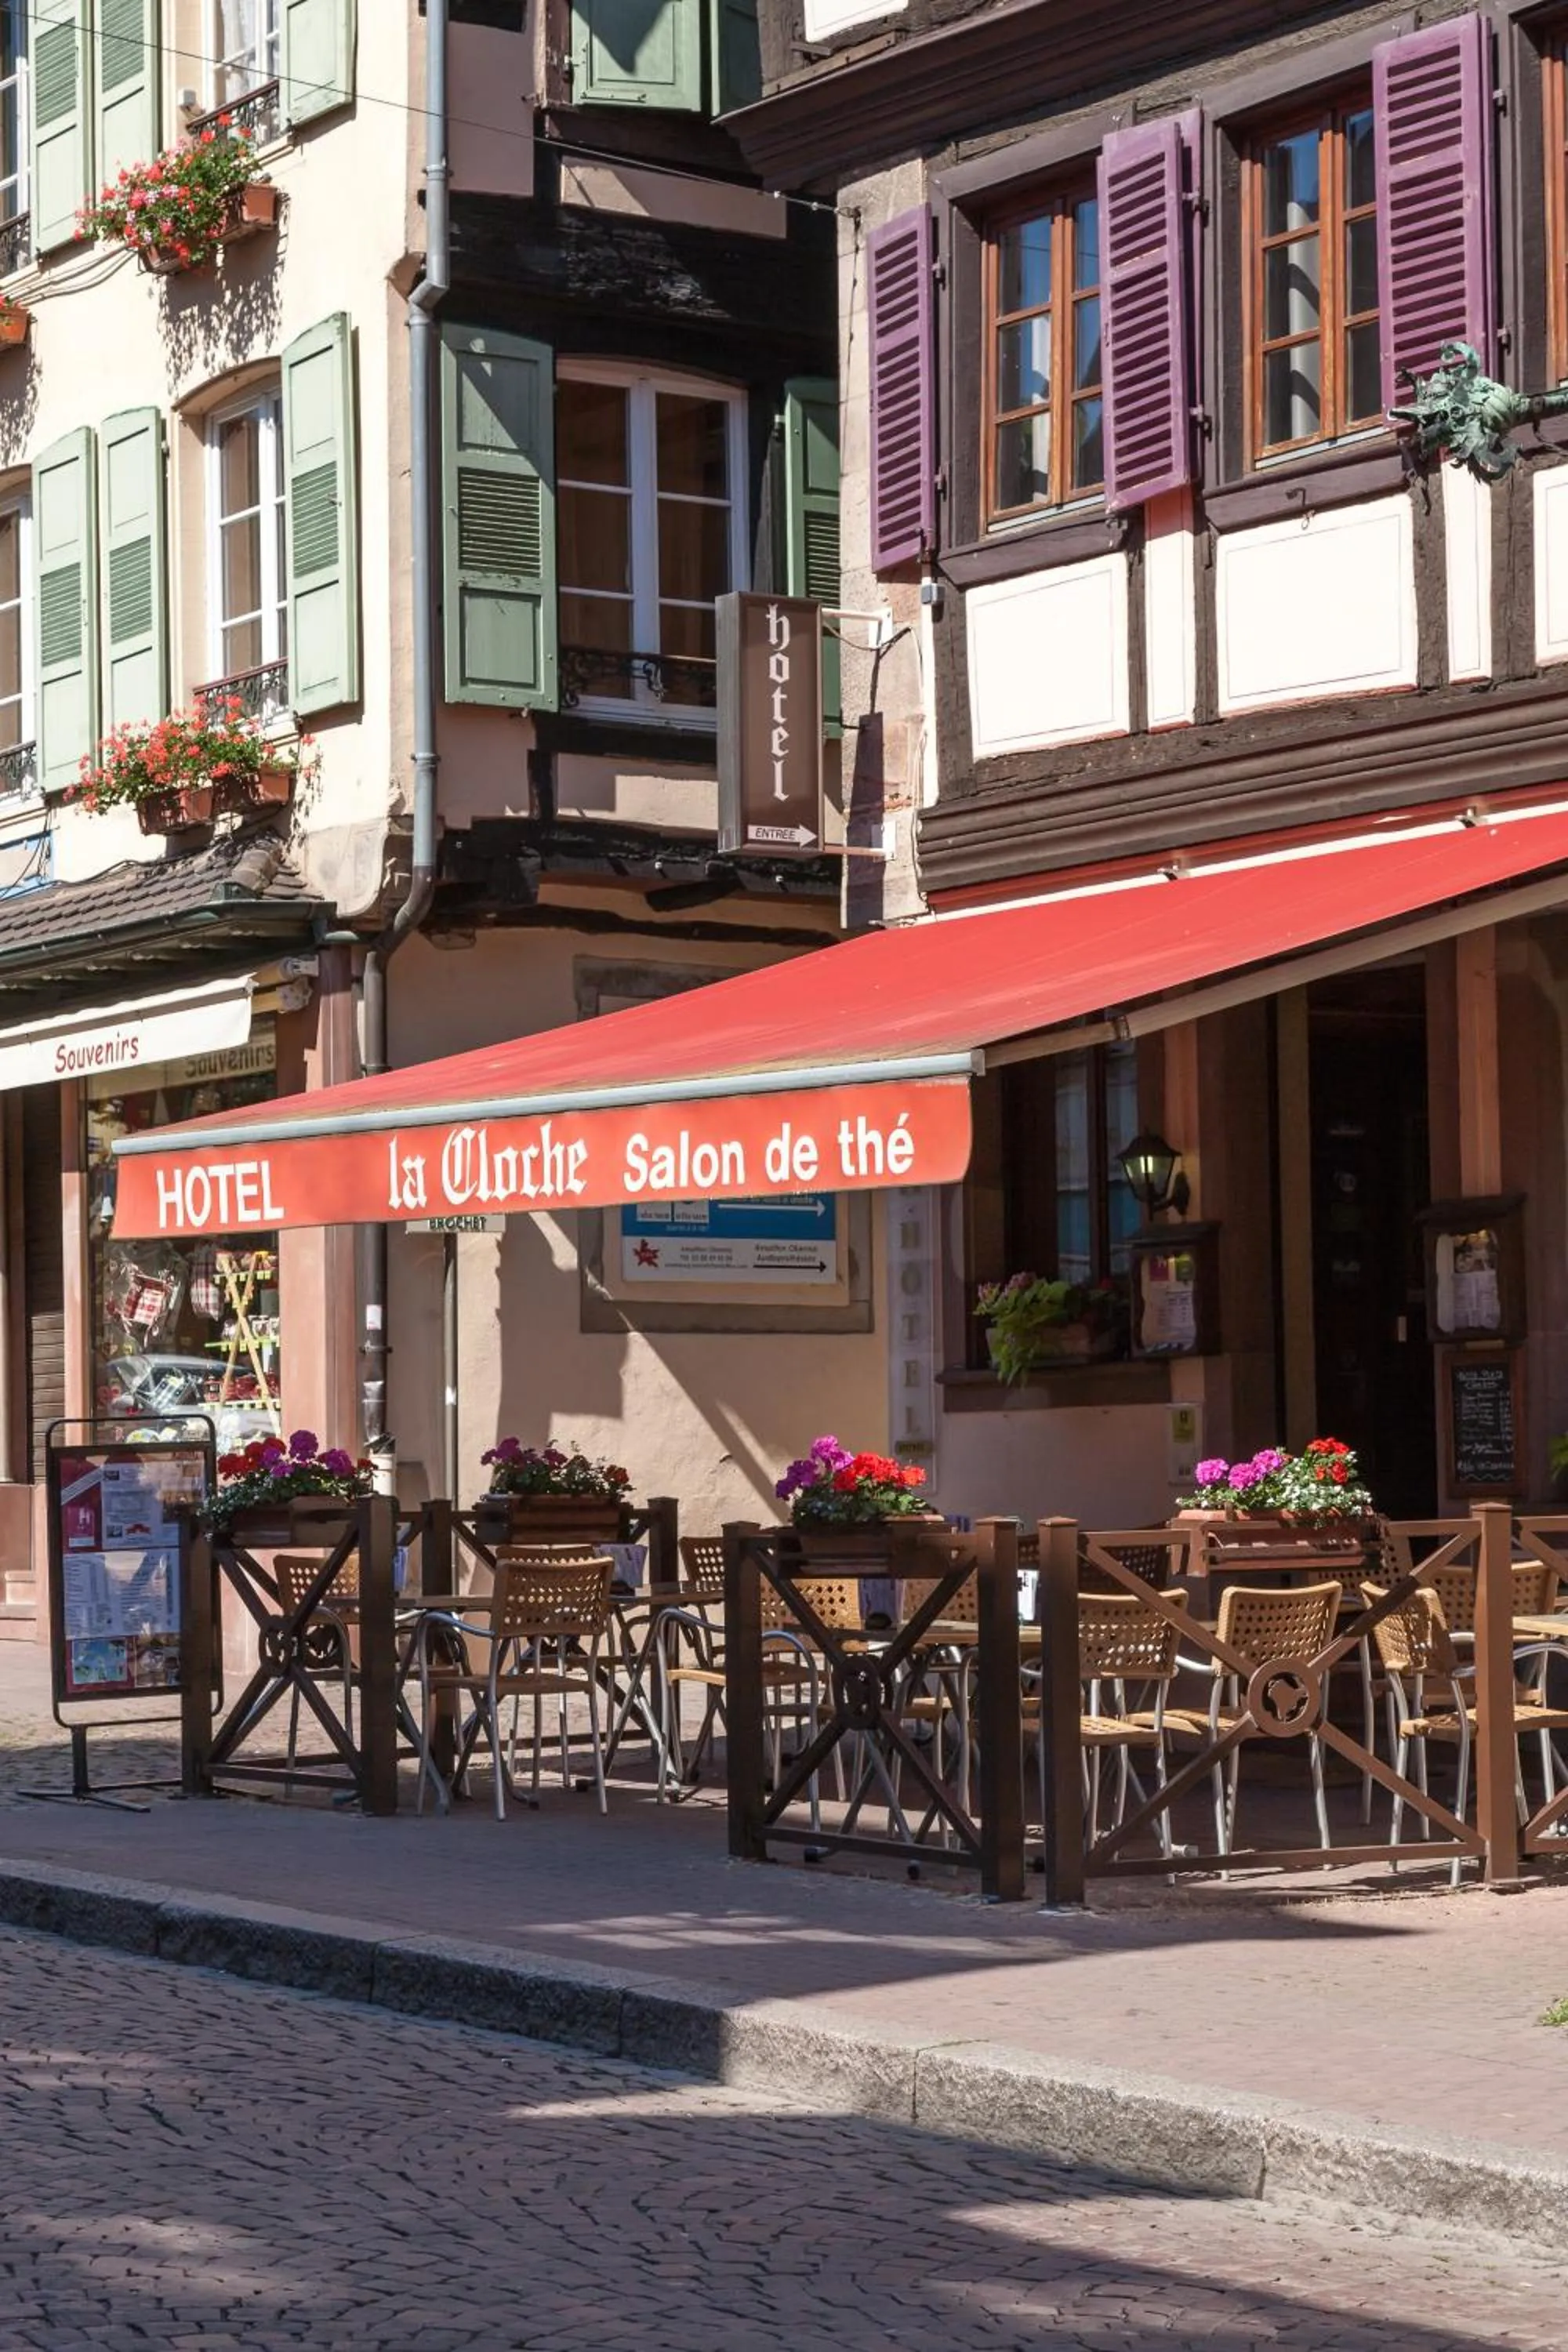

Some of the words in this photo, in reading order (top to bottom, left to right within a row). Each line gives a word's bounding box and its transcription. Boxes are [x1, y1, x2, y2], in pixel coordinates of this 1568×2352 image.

[765, 603, 791, 802] hotel
[55, 1033, 140, 1073] Souvenirs
[157, 1160, 285, 1229] HOTEL
[388, 1136, 427, 1209] la
[441, 1120, 587, 1205] Cloche
[623, 1130, 746, 1192] Salon
[764, 1123, 818, 1182] de
[838, 1112, 915, 1176] thé
